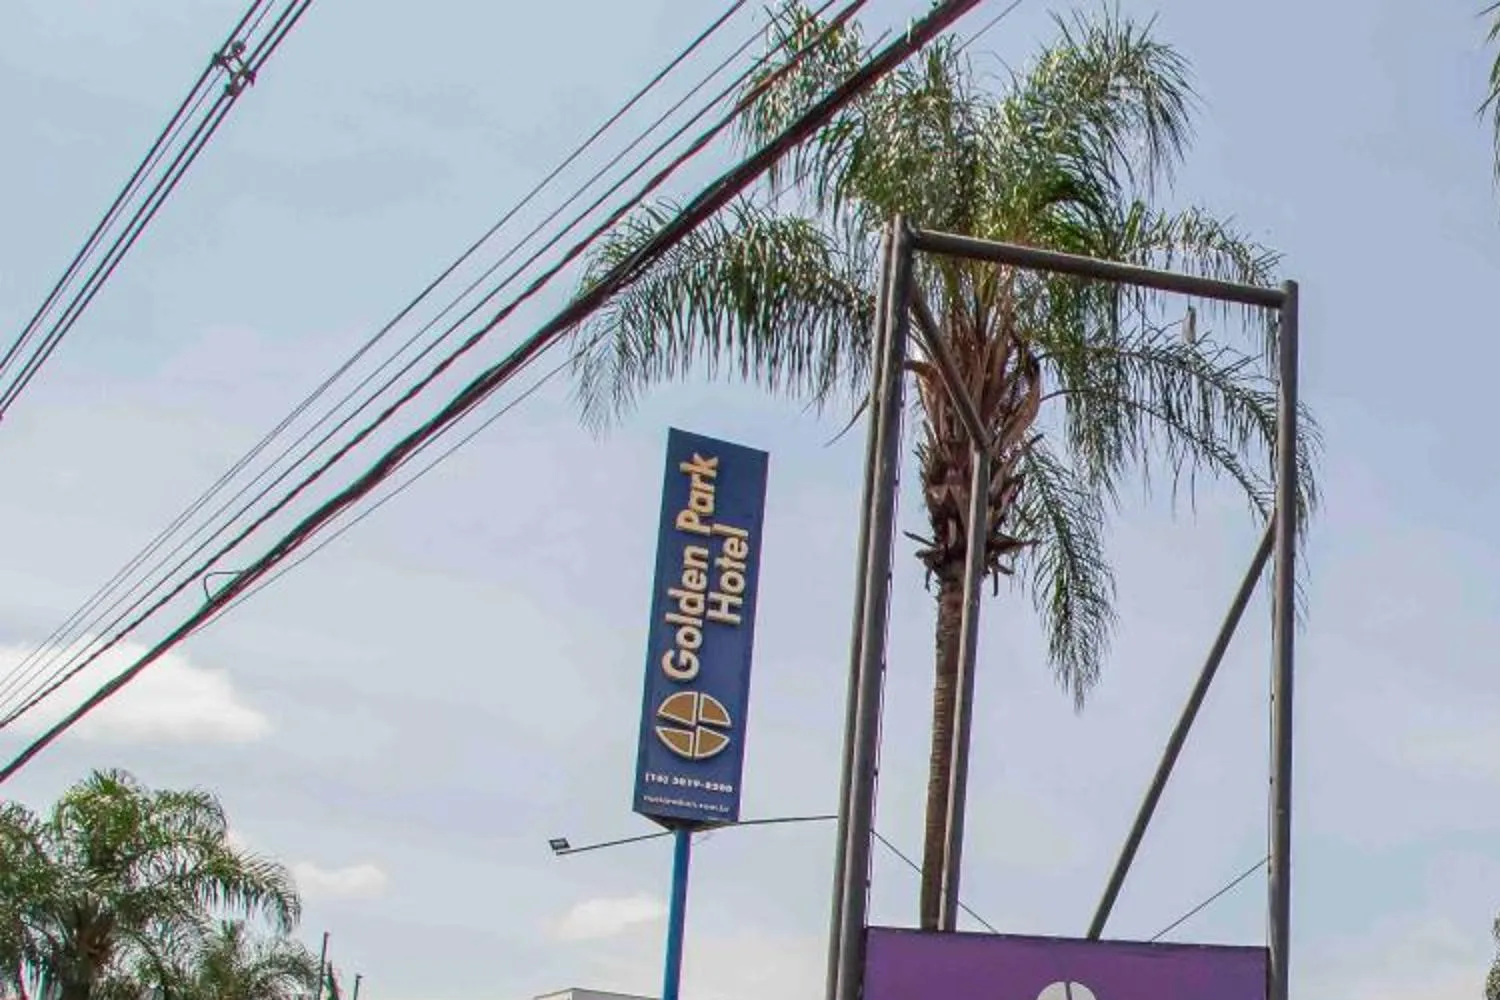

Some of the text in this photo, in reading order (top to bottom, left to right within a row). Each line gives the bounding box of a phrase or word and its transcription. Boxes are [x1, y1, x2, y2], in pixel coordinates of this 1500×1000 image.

[662, 452, 720, 682] Golden Park
[705, 523, 750, 626] Hotel
